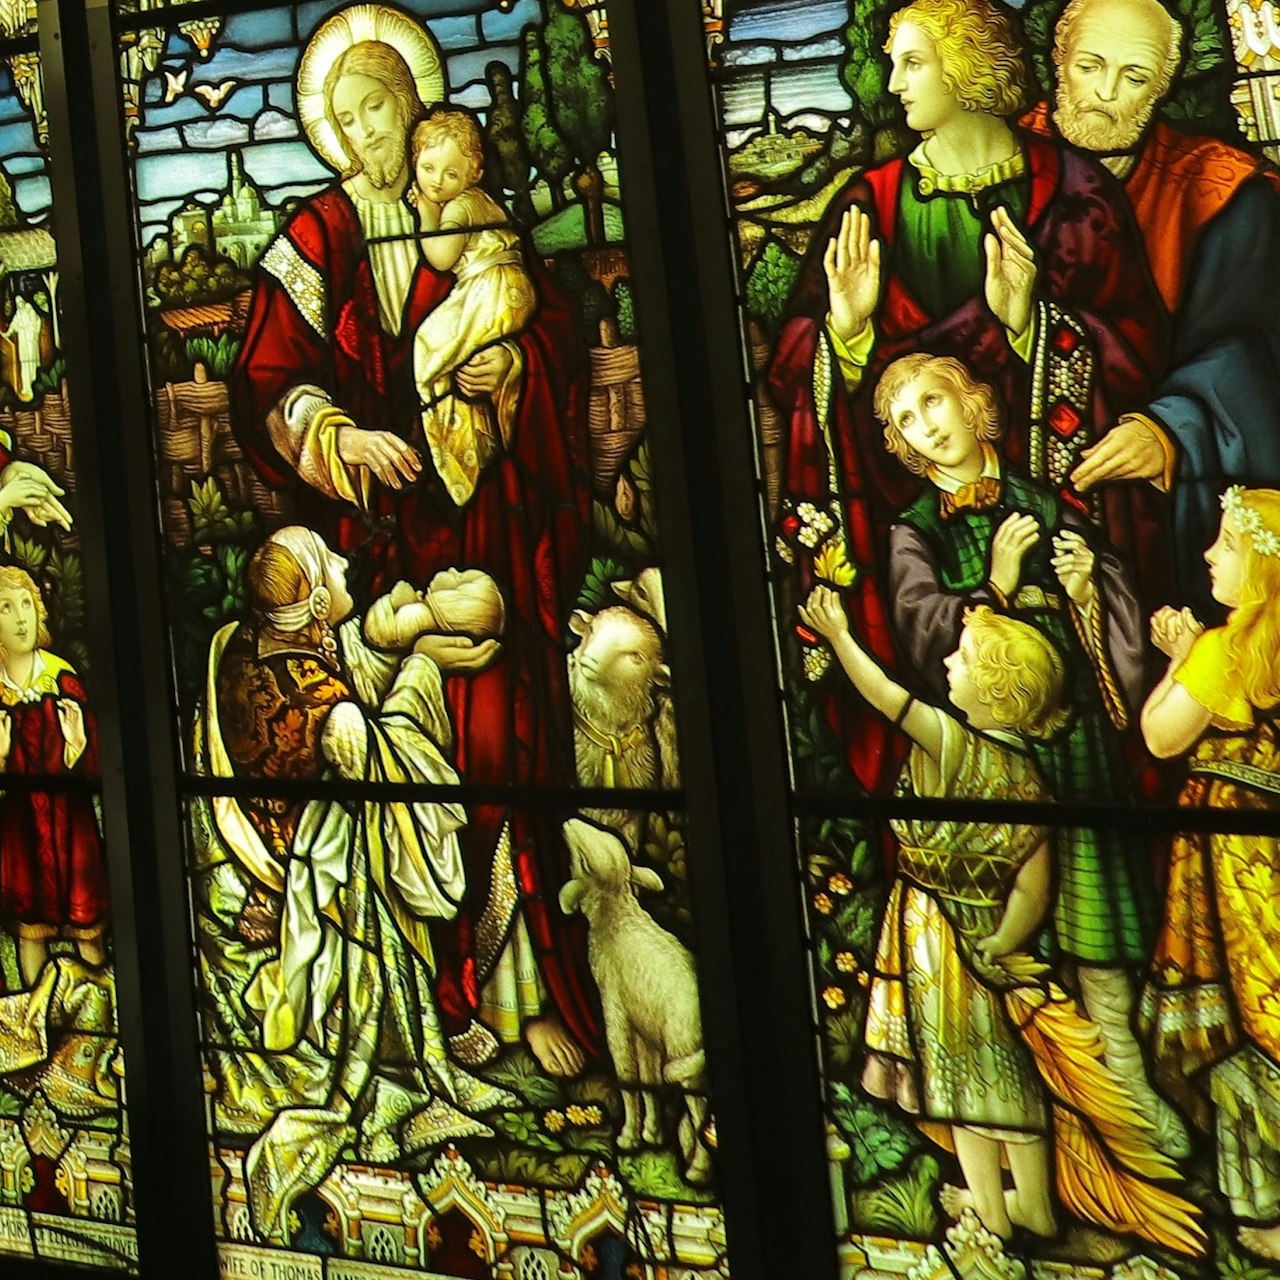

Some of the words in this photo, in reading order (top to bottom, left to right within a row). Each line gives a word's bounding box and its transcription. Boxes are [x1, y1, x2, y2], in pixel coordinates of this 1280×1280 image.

[218, 1254, 246, 1275] WIFE
[250, 1260, 266, 1280] OF
[270, 1263, 321, 1280] THOMAS
